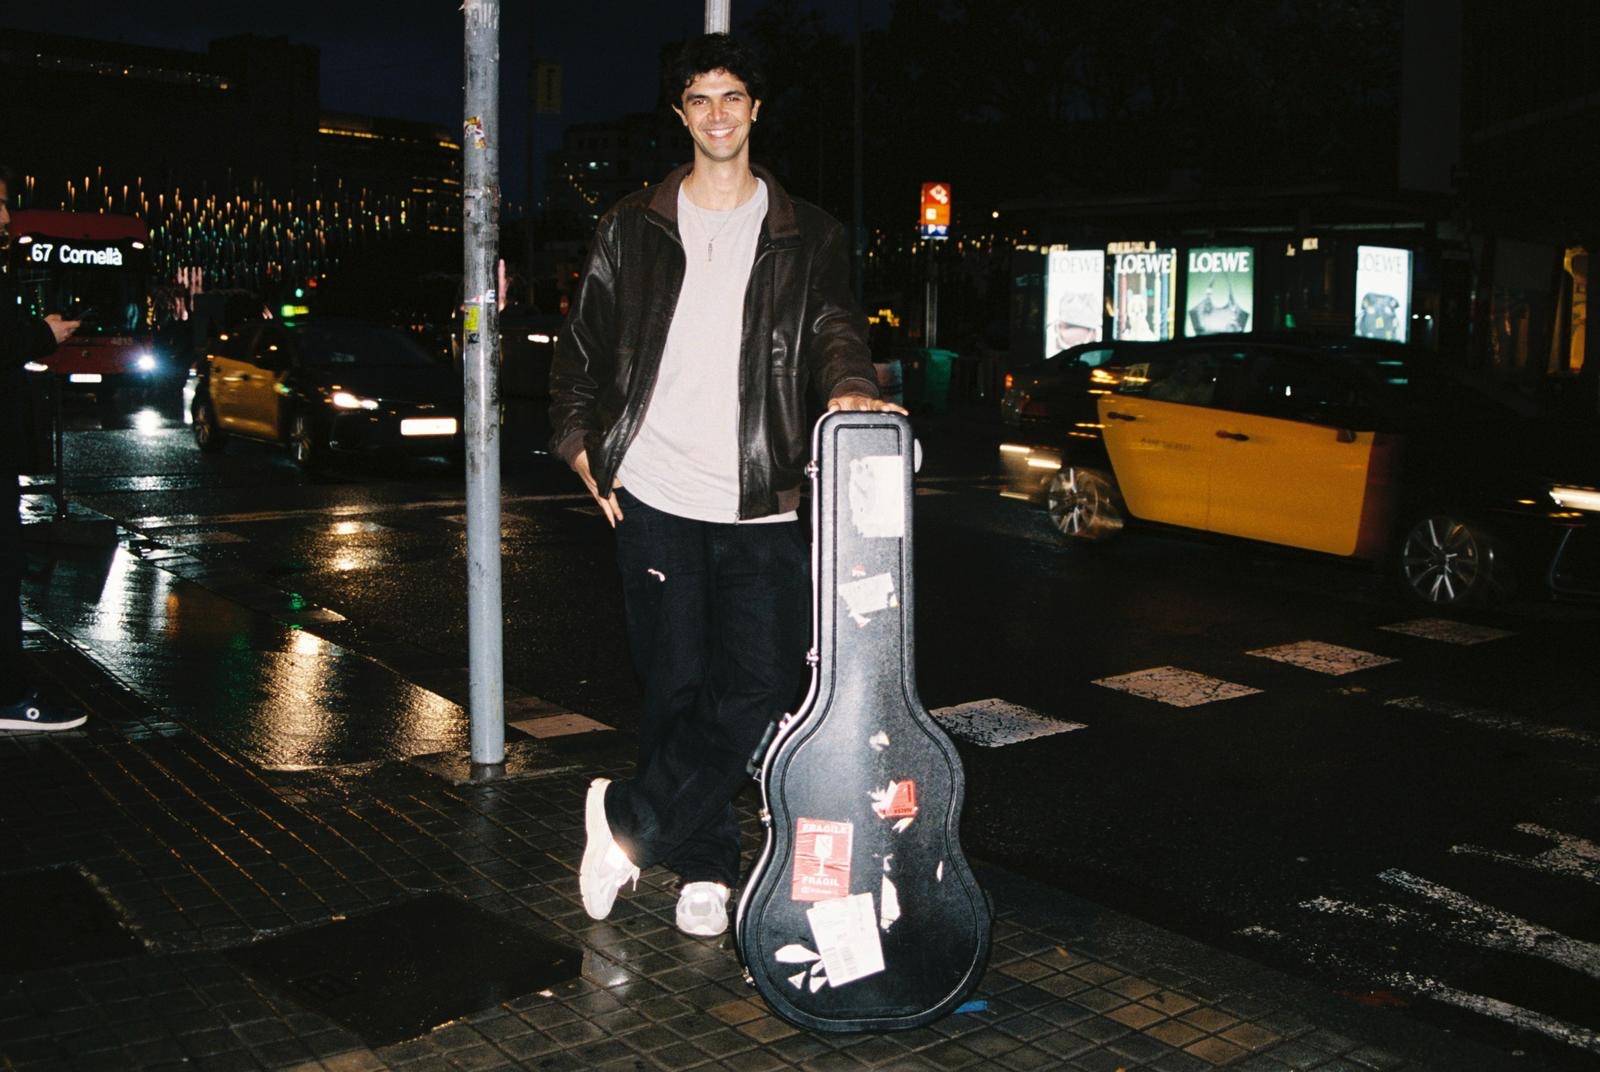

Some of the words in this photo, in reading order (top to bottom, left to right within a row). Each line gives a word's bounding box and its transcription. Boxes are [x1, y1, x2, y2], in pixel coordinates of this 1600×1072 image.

[31, 243, 53, 262] 67
[59, 244, 123, 266] Cornellà
[1115, 253, 1171, 274] LOEWE
[1189, 251, 1250, 273] LOEWE
[801, 875, 840, 887] FRAGIL
